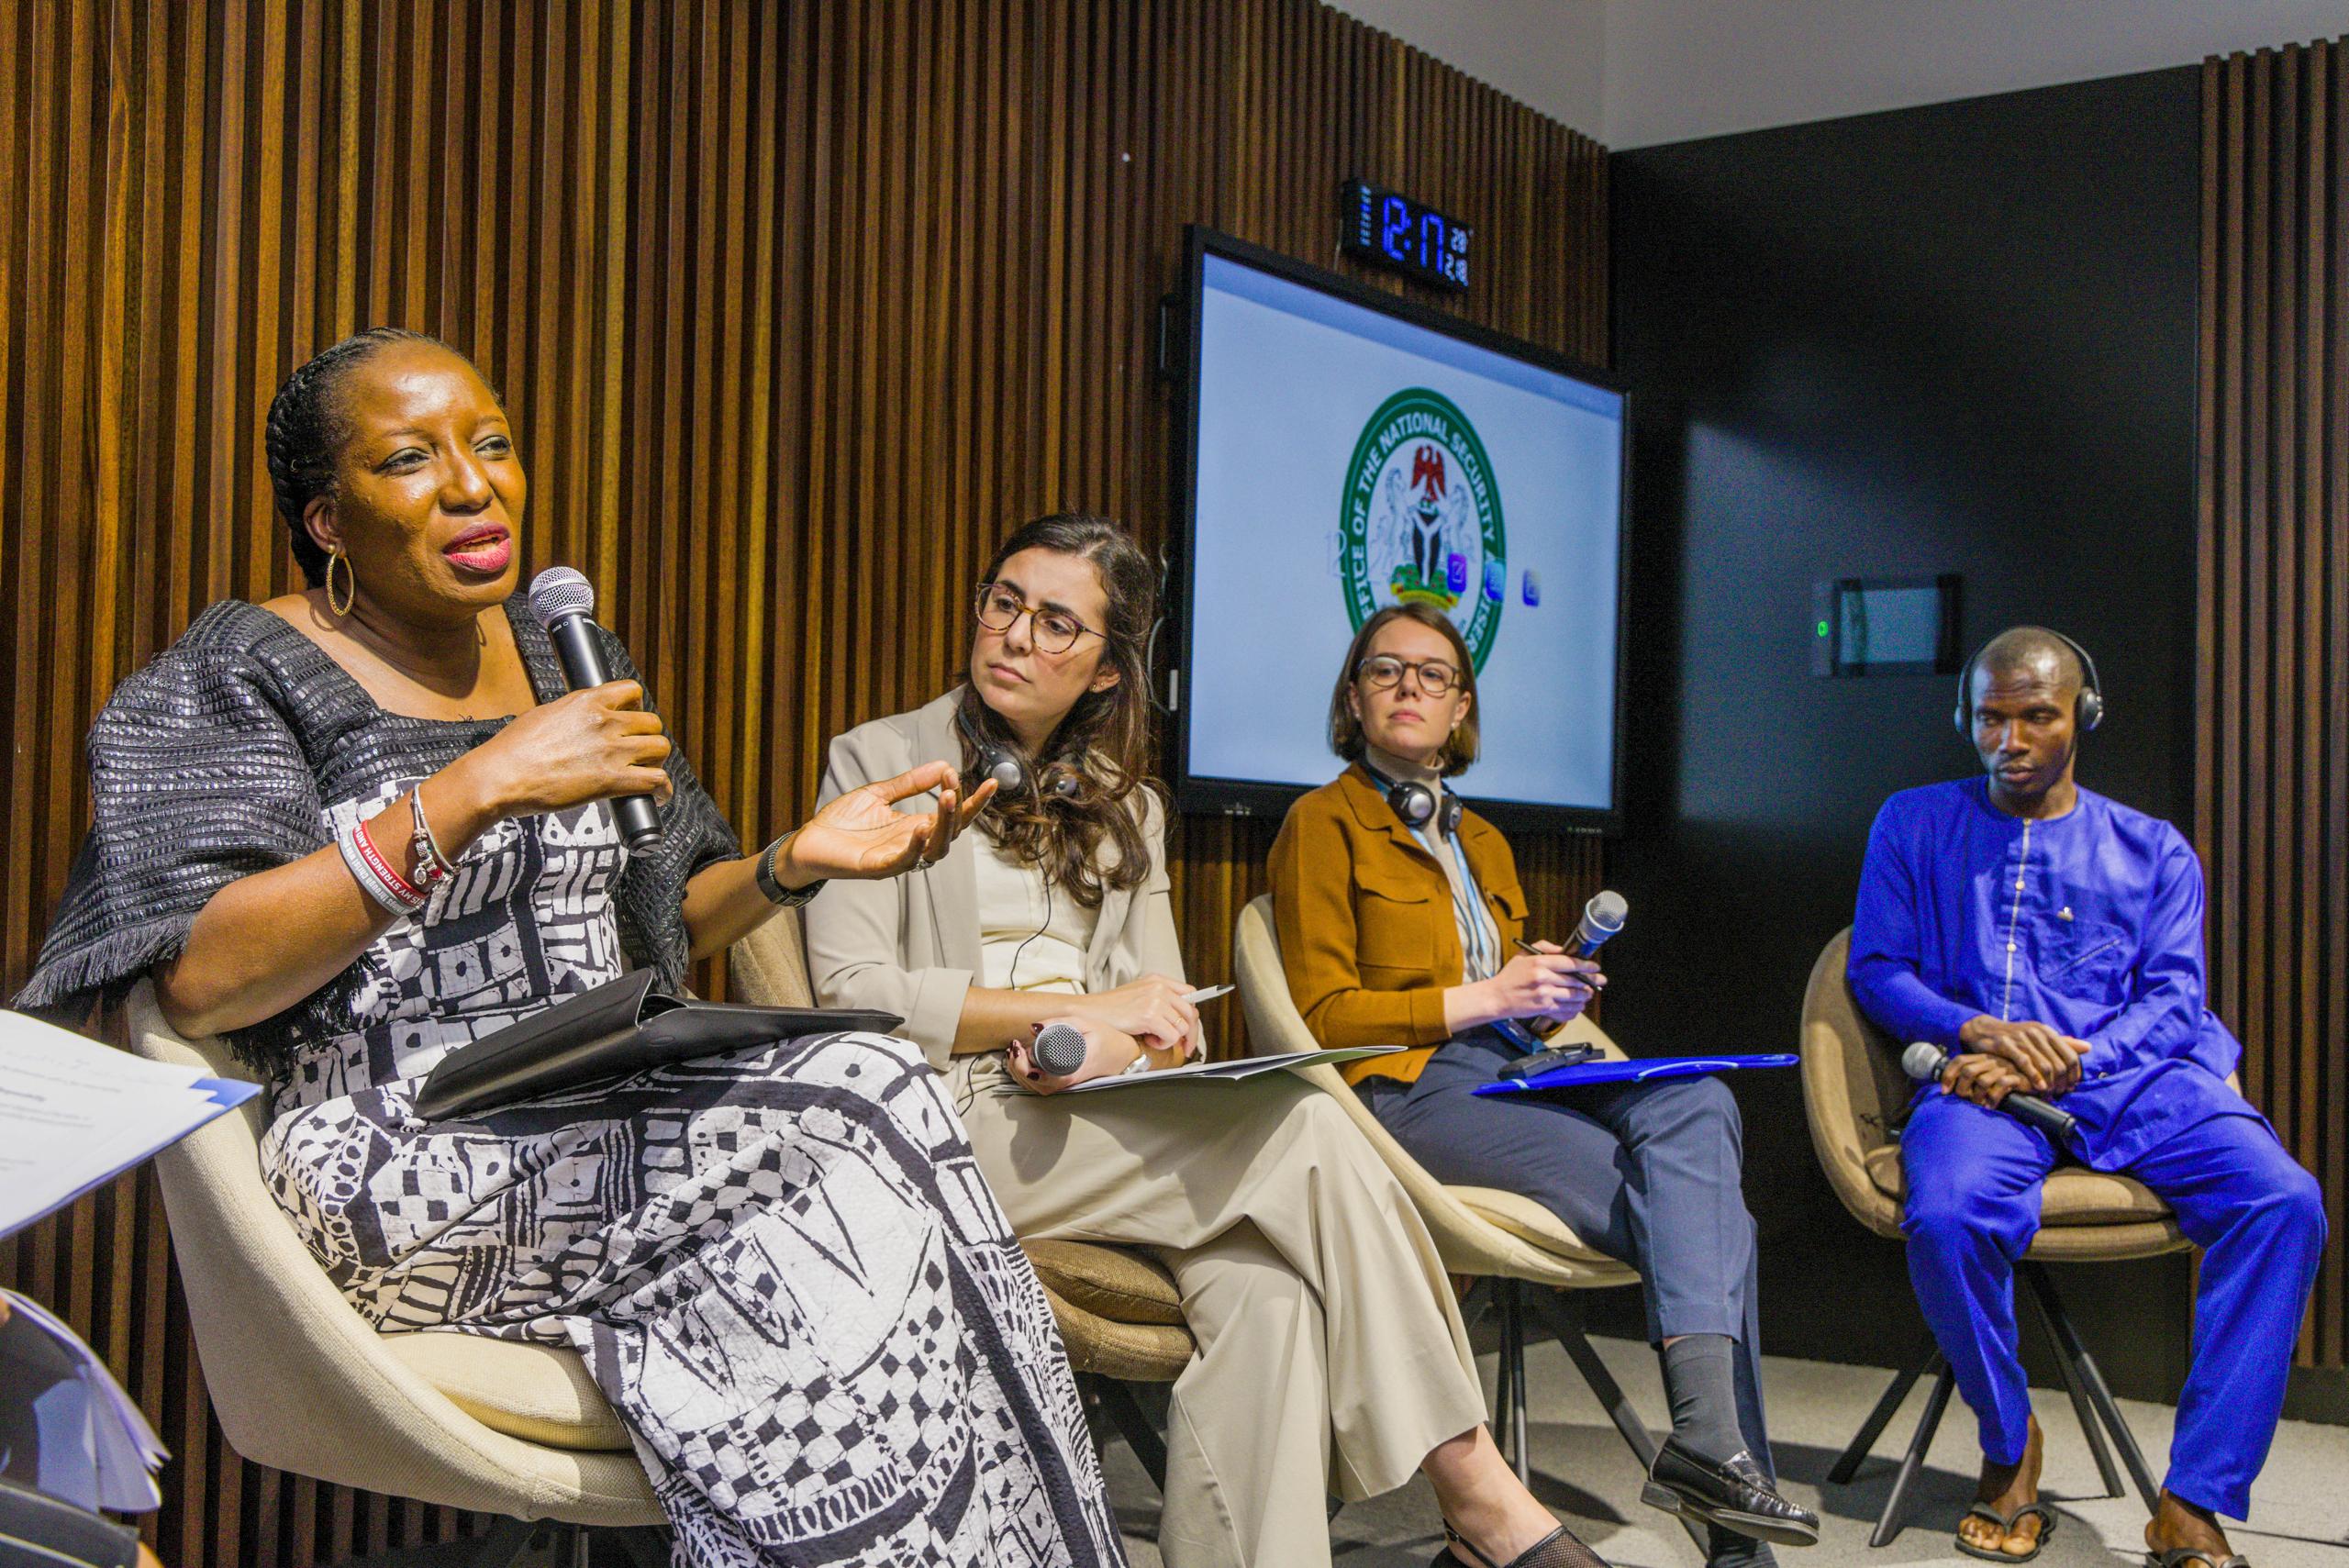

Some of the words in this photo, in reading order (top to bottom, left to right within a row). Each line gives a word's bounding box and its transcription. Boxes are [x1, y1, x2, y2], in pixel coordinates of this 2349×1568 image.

[1379, 411, 1449, 455] NATIONAL
[1358, 446, 1383, 493] THE
[1450, 431, 1496, 542] SECURITY
[1353, 497, 1366, 537] OF
[1352, 545, 1375, 621] FFICE
[356, 830, 369, 848] AND
[351, 858, 369, 880] Christ
[363, 847, 402, 890] STRENGTH
[366, 877, 390, 902] through
[398, 889, 413, 900] MY
